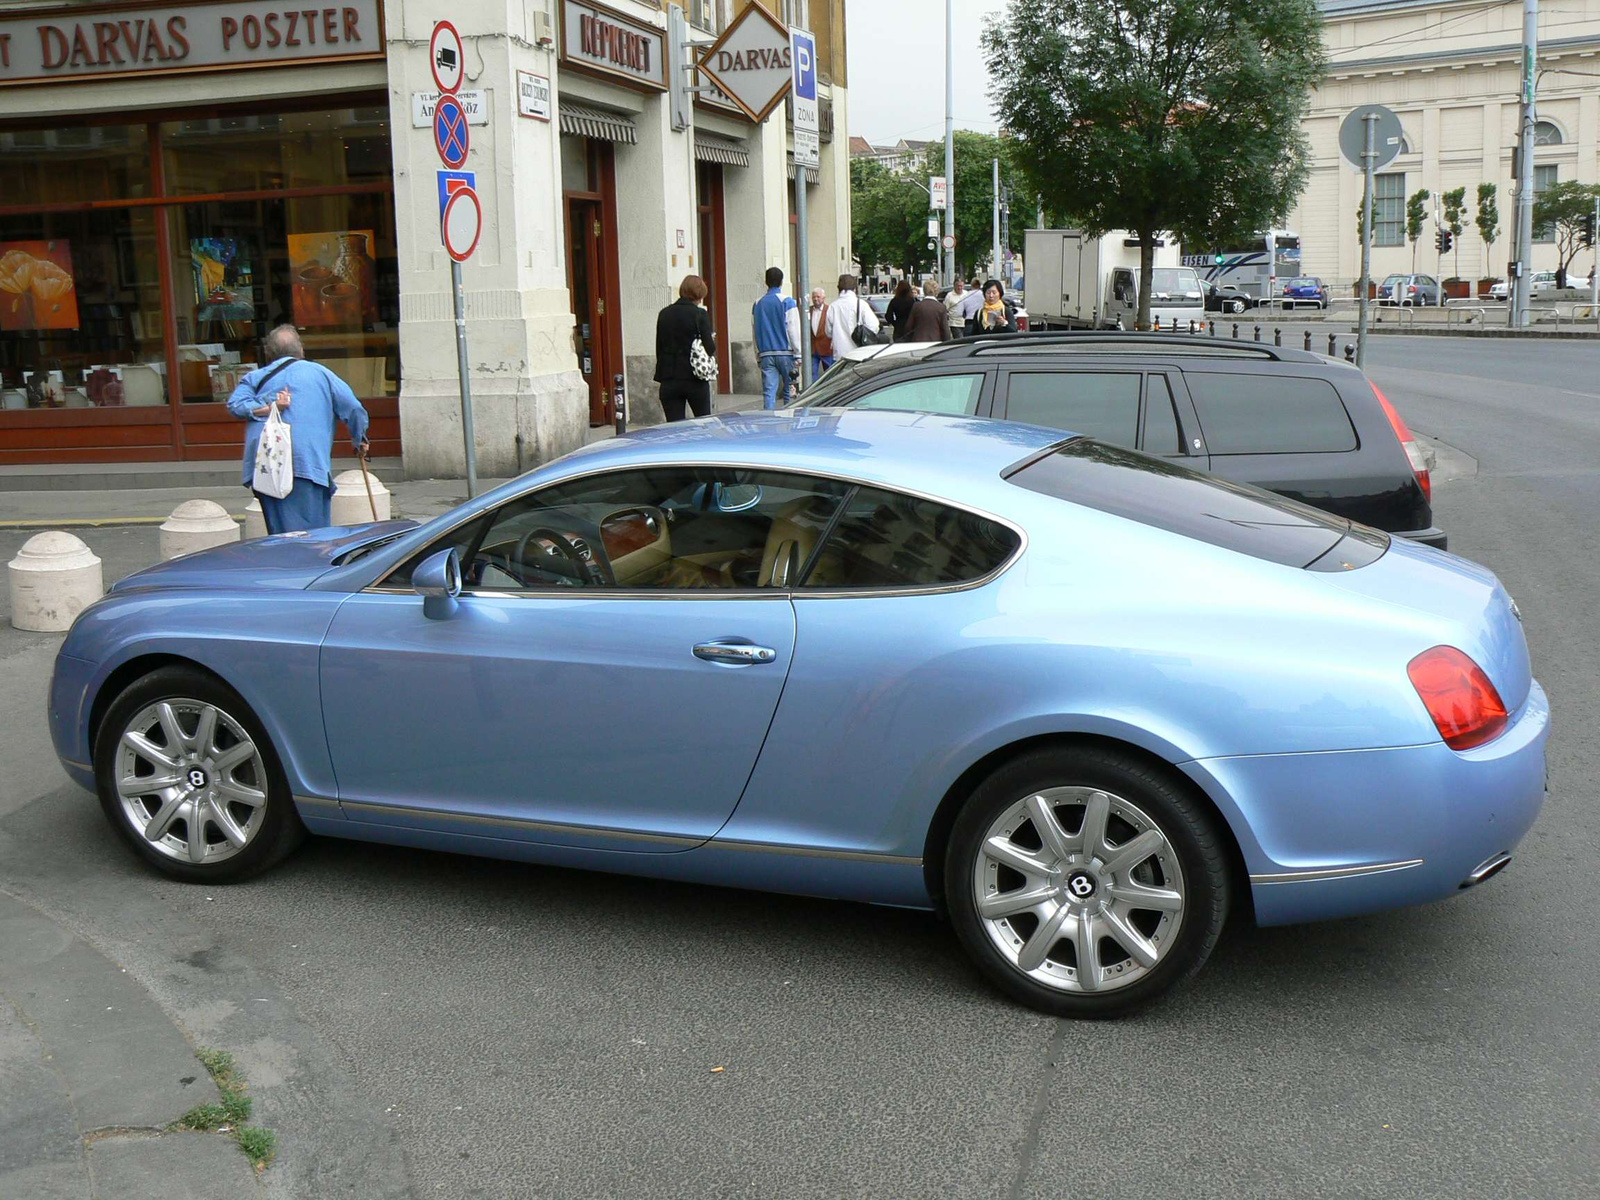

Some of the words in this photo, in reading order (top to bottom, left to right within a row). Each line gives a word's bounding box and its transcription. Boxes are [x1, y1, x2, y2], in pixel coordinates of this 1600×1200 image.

[36, 16, 190, 69] DARVAS
[221, 7, 362, 50] POSZTER
[580, 12, 652, 73] KÉPKERET
[718, 47, 791, 72] DARVAS
[797, 46, 810, 87] P
[797, 107, 815, 122] ZONA
[1181, 255, 1209, 266] EISEN
